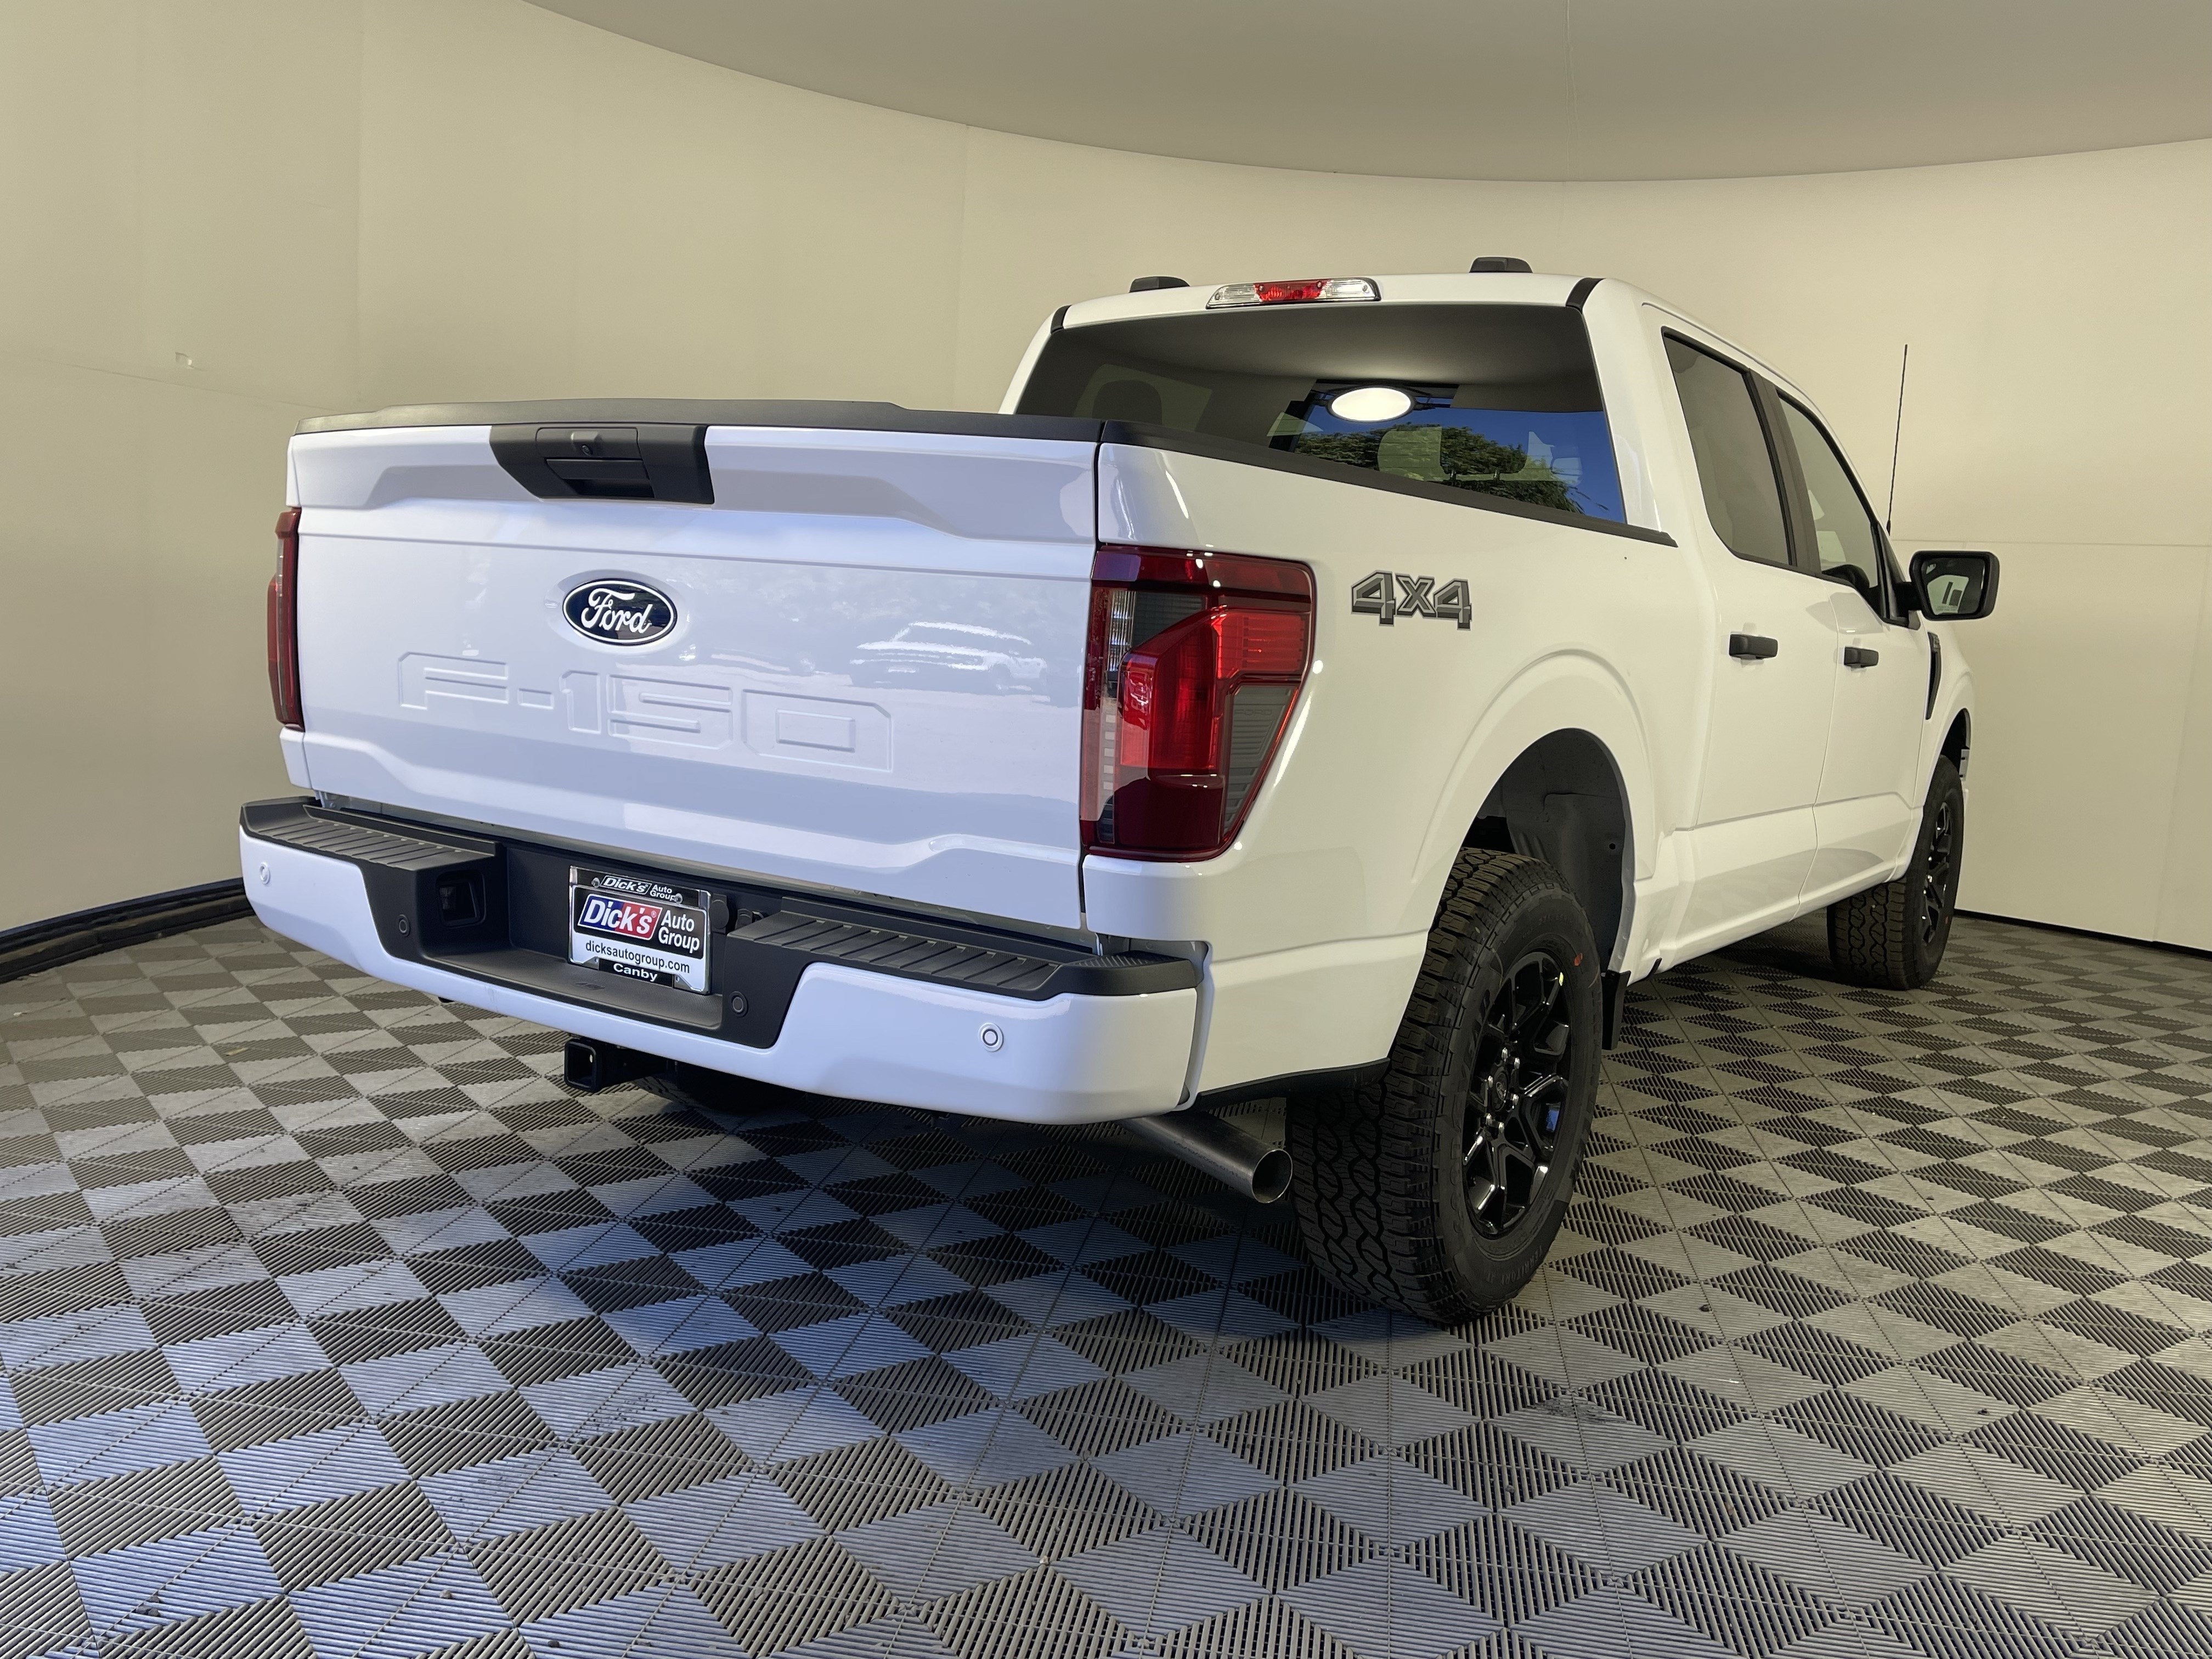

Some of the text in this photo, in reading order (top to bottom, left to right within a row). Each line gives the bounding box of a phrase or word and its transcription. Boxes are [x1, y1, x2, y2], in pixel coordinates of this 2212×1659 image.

[580, 588, 653, 635] Ford
[398, 651, 893, 773] F-150
[603, 877, 646, 893] Dick's
[652, 884, 673, 894] Auto
[583, 899, 653, 934] Dick's
[661, 910, 695, 932] Auto
[658, 927, 700, 953] Group
[585, 940, 690, 974] dicksautogroup.com
[613, 963, 658, 982] Canby
